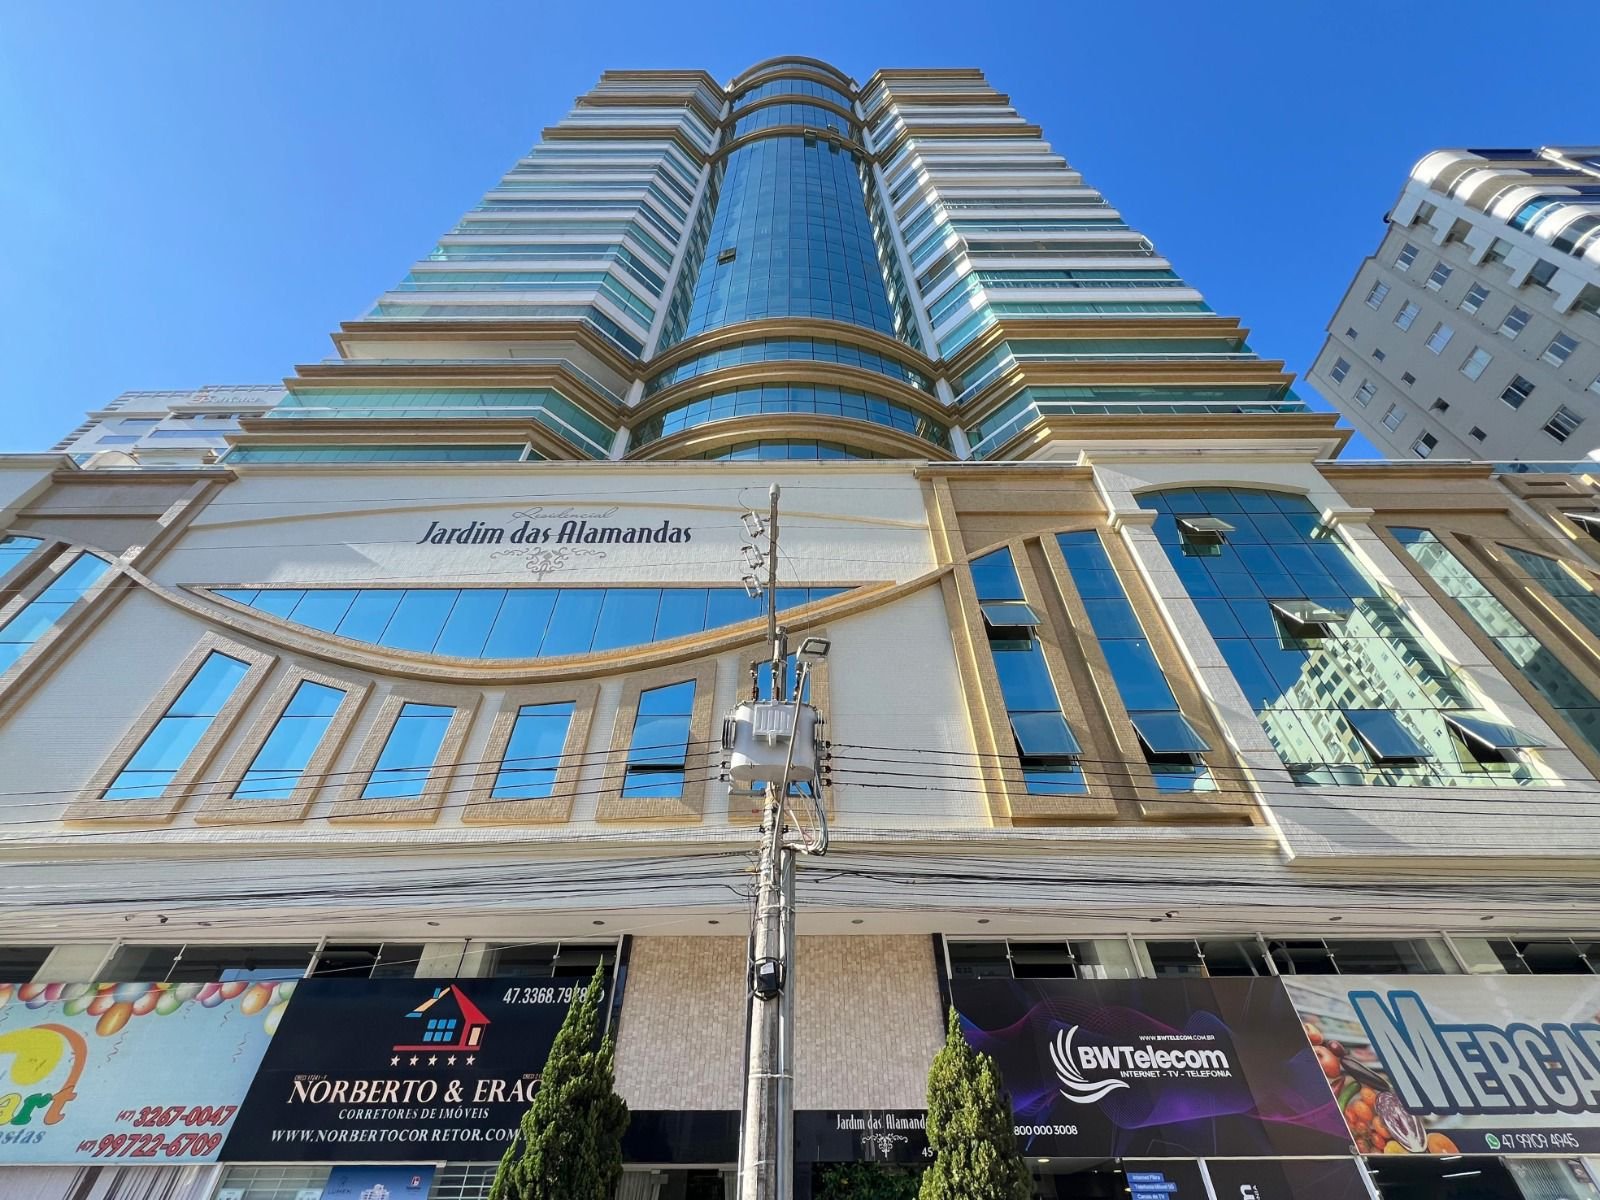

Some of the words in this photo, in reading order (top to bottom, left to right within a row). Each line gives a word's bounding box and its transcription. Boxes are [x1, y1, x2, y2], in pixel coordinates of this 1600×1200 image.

[506, 506, 619, 524] Residencial
[416, 521, 504, 545] Jardim
[510, 521, 551, 544] das
[556, 520, 692, 544] Alamandas
[1077, 1045, 1230, 1069] BWTelecom
[1347, 990, 1600, 1115] MERCA
[1120, 1070, 1161, 1078] INTERNET
[1169, 1070, 1179, 1078] TV
[1187, 1070, 1232, 1078] TELEFONIA
[286, 1079, 438, 1104] NORBERTO
[443, 1079, 464, 1103] &
[114, 1110, 136, 1122] (47)
[132, 1105, 238, 1128] 3267-0047
[338, 1108, 418, 1120] CORRETORES
[420, 1108, 437, 1120] DE
[438, 1105, 490, 1120] IMÓVEIS
[836, 1113, 866, 1130] Jardim
[867, 1113, 882, 1130] das
[886, 1113, 929, 1130] Alamand
[0, 1129, 46, 1144] stas
[1033, 1125, 1053, 1136] 000
[1053, 1125, 1078, 1135] 3008
[75, 1139, 97, 1153] (47)
[91, 1132, 223, 1158] 99722-6709
[1502, 1134, 1515, 1148] 47
[1515, 1133, 1549, 1149] 99109
[1550, 1133, 1580, 1148] 4945
